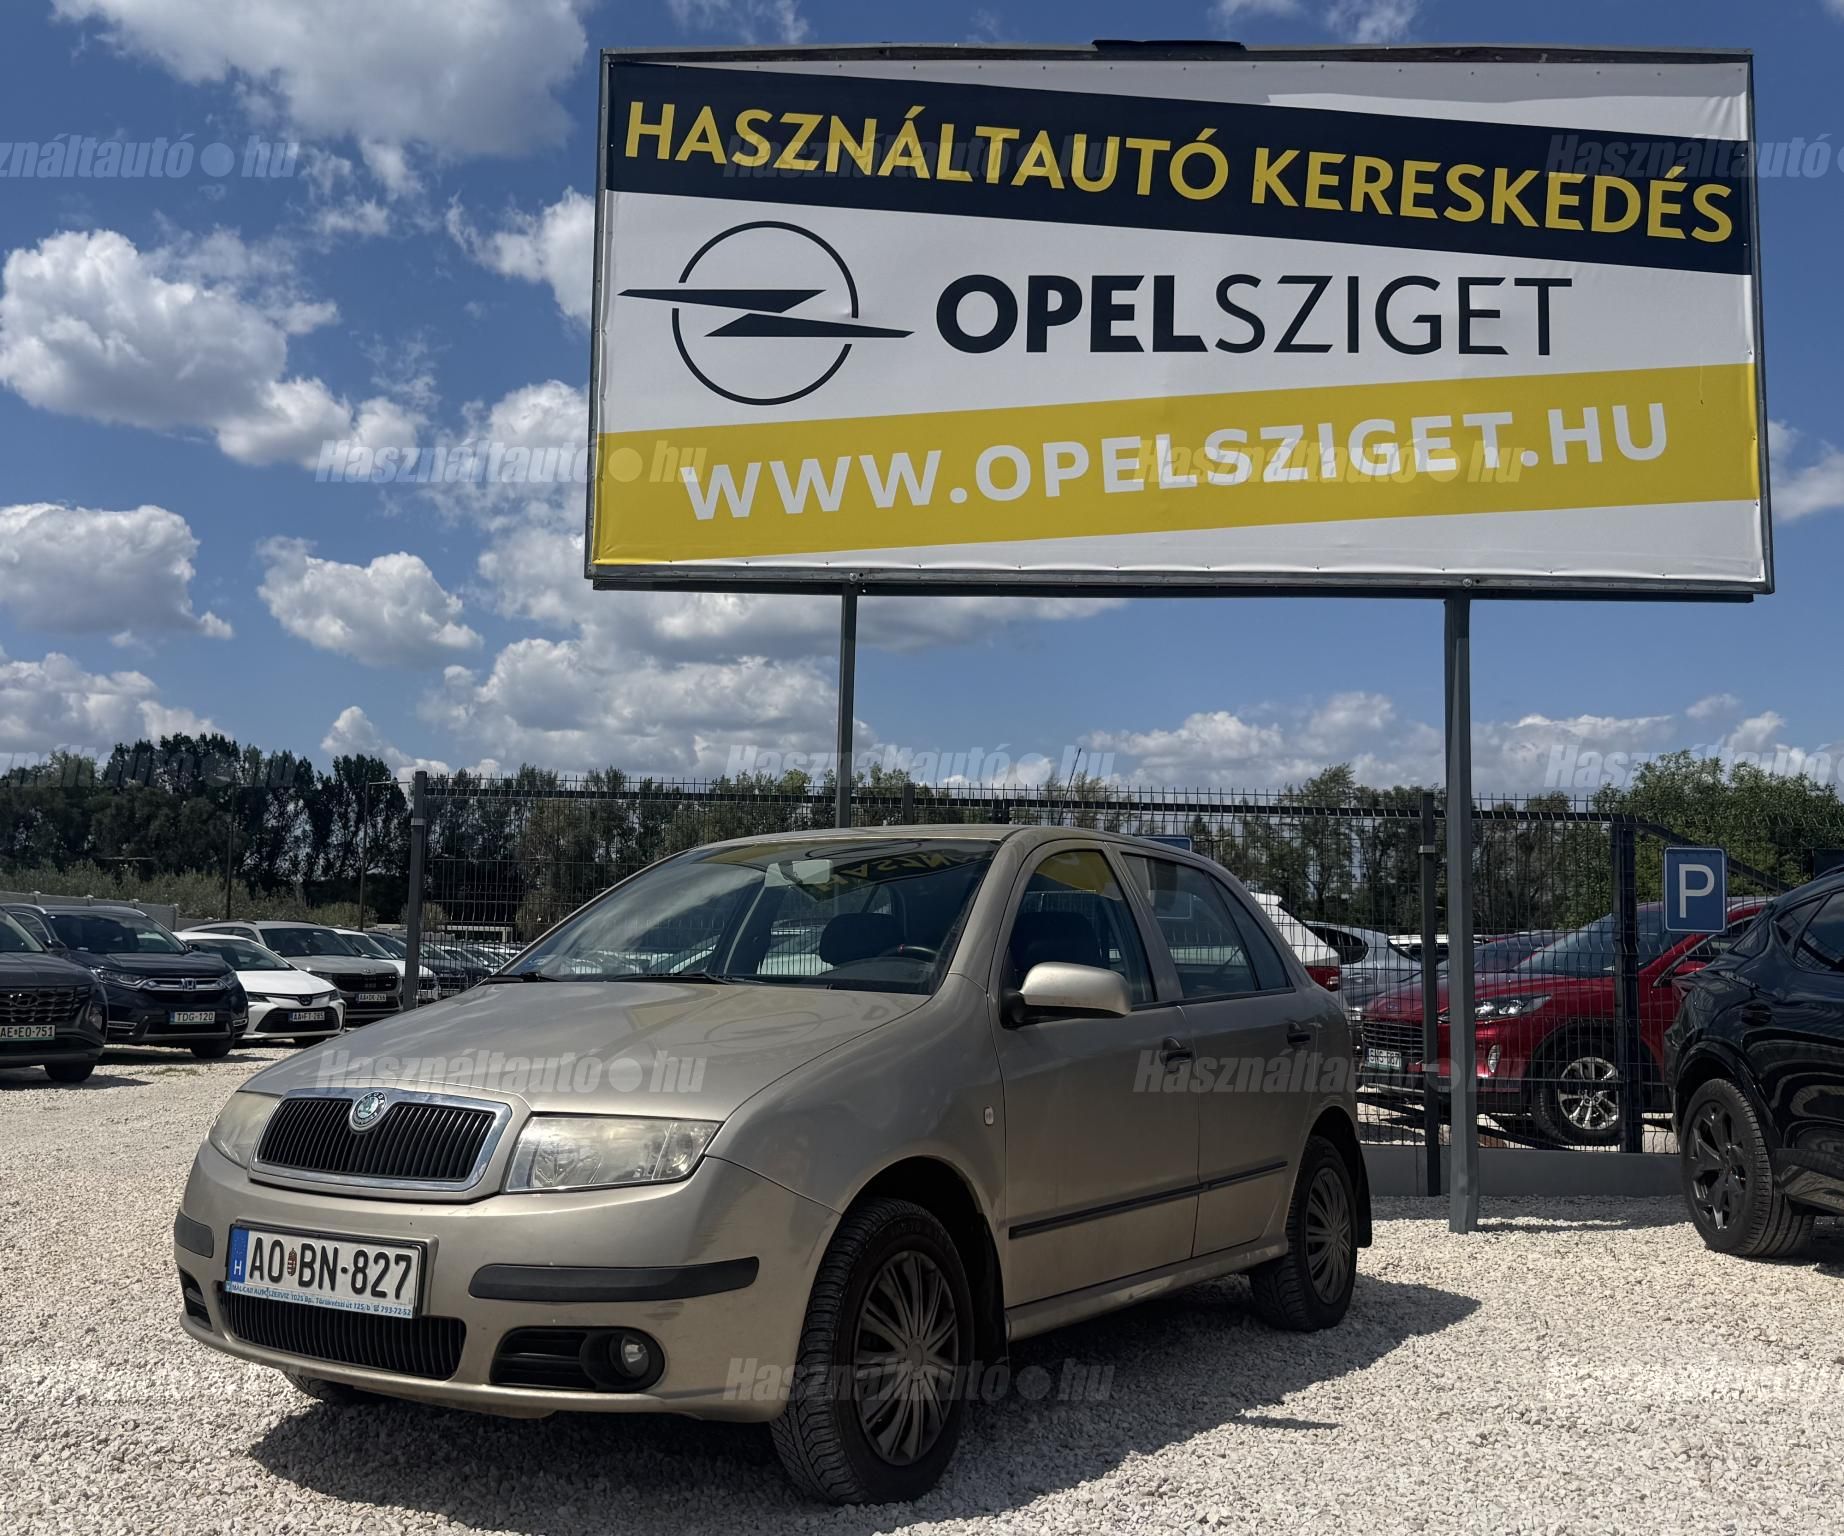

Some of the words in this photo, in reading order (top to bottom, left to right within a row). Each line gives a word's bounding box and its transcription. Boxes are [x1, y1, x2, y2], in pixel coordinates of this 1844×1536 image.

[625, 101, 1229, 201] HASZNÁLTAUTÓ
[1250, 147, 1733, 243] KERESKEDÉS
[935, 273, 1572, 355] OPELSZIGET
[680, 402, 1668, 520] WWW.OPELSZIGET.HU
[1678, 863, 1715, 919] P
